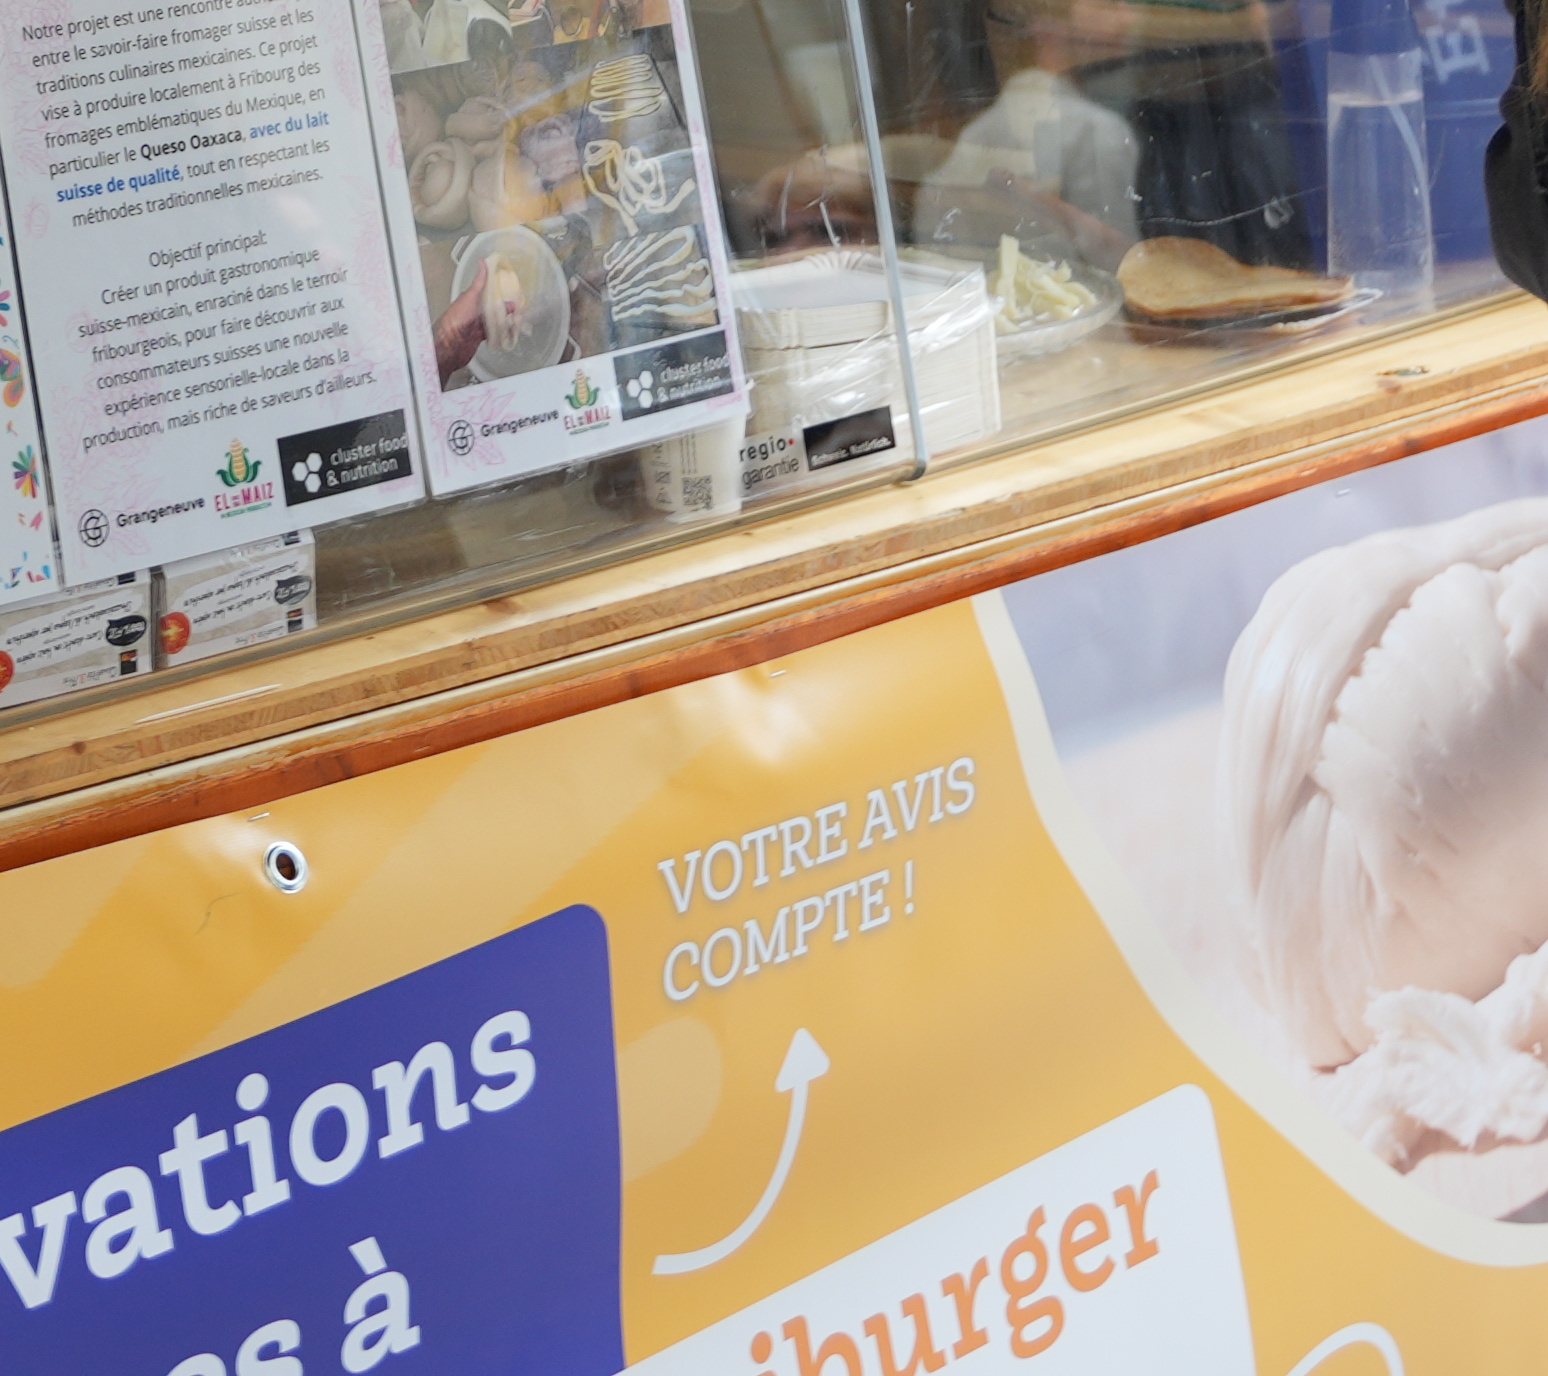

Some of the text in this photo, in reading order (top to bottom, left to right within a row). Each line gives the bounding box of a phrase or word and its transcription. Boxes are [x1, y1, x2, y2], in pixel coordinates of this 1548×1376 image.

[22, 24, 64, 42] Notre
[66, 15, 111, 40] projet
[113, 11, 135, 27] est
[137, 8, 164, 23] une
[32, 9, 314, 68] entre le savoir-faire fromager suisse et les
[35, 35, 318, 95] traditions culinaires mexicaines. Ce projet
[40, 61, 321, 122] vise à produire localement à Fribourg des
[44, 88, 325, 149] fromages emblématiques du Mexique, en
[49, 111, 329, 180] particulier le Queso Oaxaca, avec du lait
[72, 168, 324, 227] méthodes traditionnelles mexicaines.
[148, 229, 267, 269] Objectif principal:
[325, 454, 399, 488] & nutrition
[329, 432, 410, 467] cluster food
[739, 435, 787, 463] regio
[741, 455, 801, 490] garantie
[115, 496, 206, 528] Grangeneuve
[213, 481, 276, 513] EL MAIZ
[657, 756, 977, 914] VOTRE AVIS
[661, 860, 916, 1002] COMPTE !
[338, 1236, 422, 1376] à
